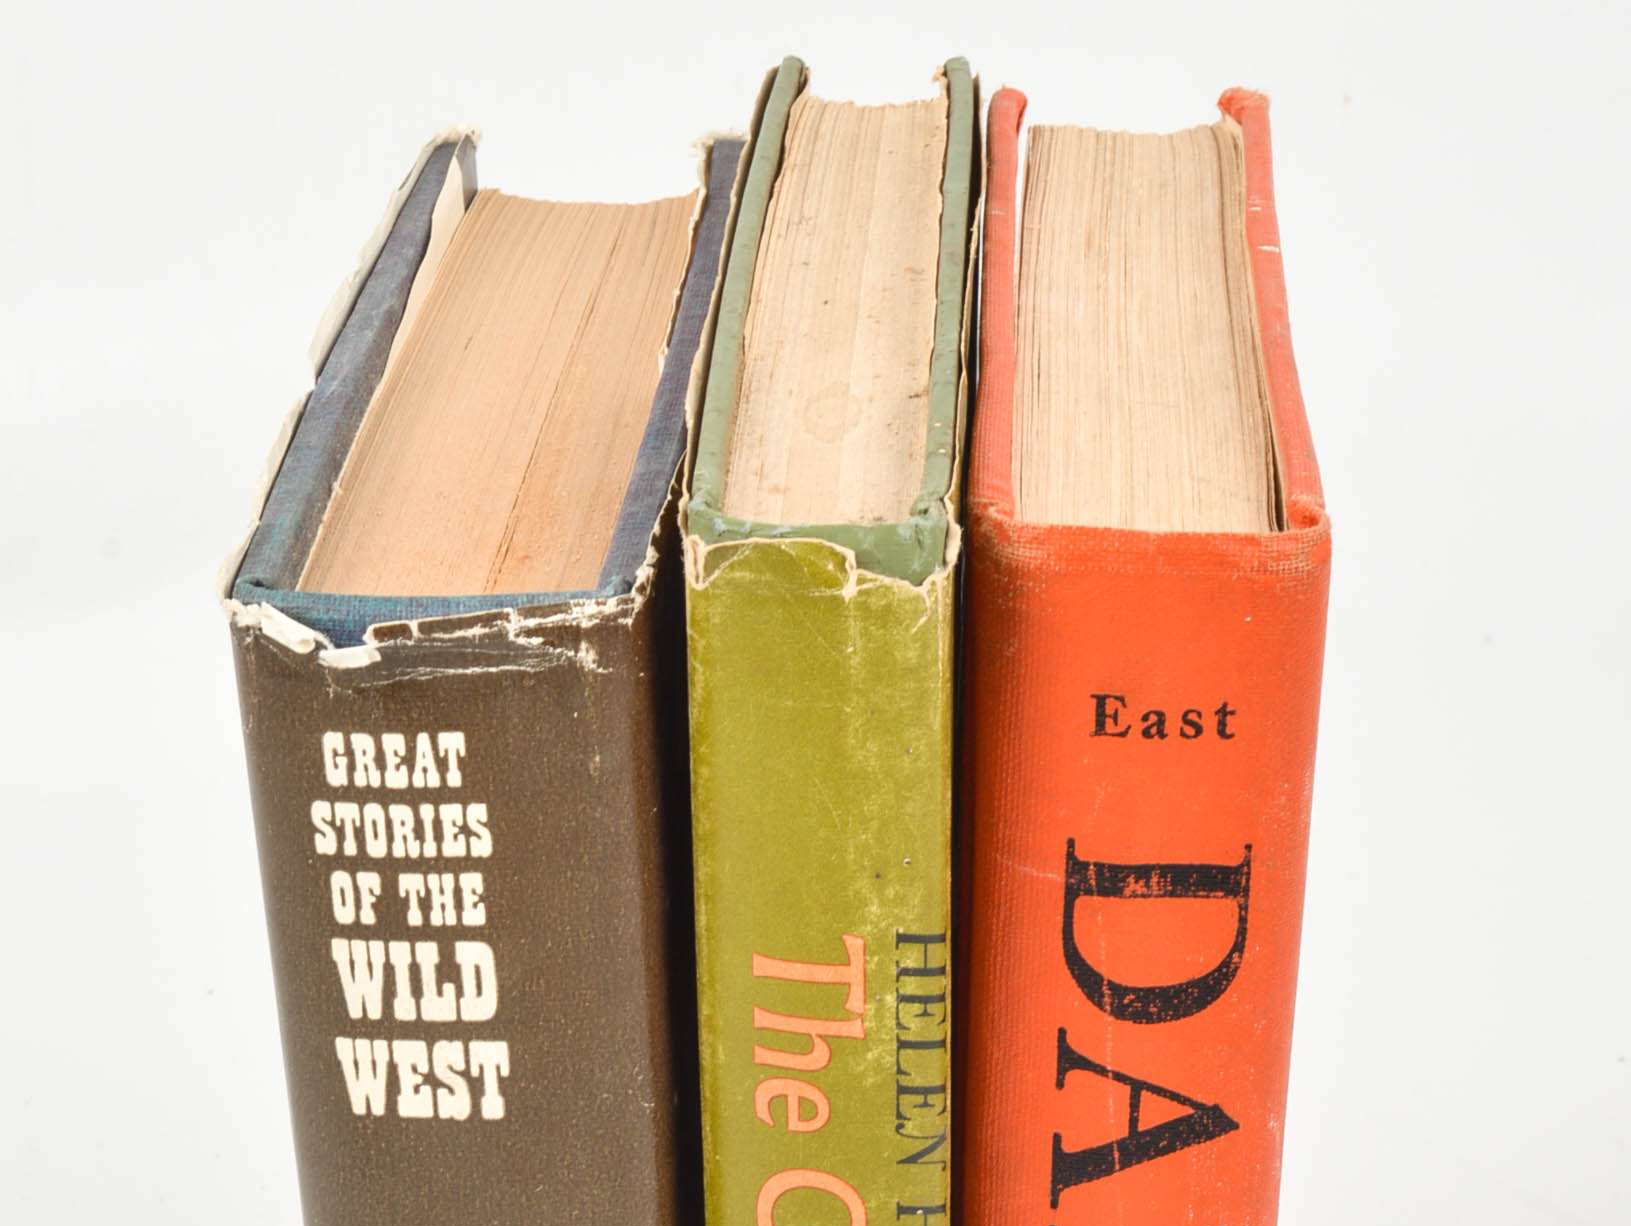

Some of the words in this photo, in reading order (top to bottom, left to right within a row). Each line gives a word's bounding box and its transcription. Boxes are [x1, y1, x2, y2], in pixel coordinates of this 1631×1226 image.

[1089, 693, 1237, 739] East
[322, 731, 466, 788] GREAT
[310, 800, 493, 858] STORIES
[330, 869, 382, 924] OF
[398, 872, 486, 926] THE
[331, 938, 499, 1022] WILD
[752, 933, 866, 1133] The
[895, 928, 946, 1171] HELEN
[335, 1036, 510, 1120] WEST
